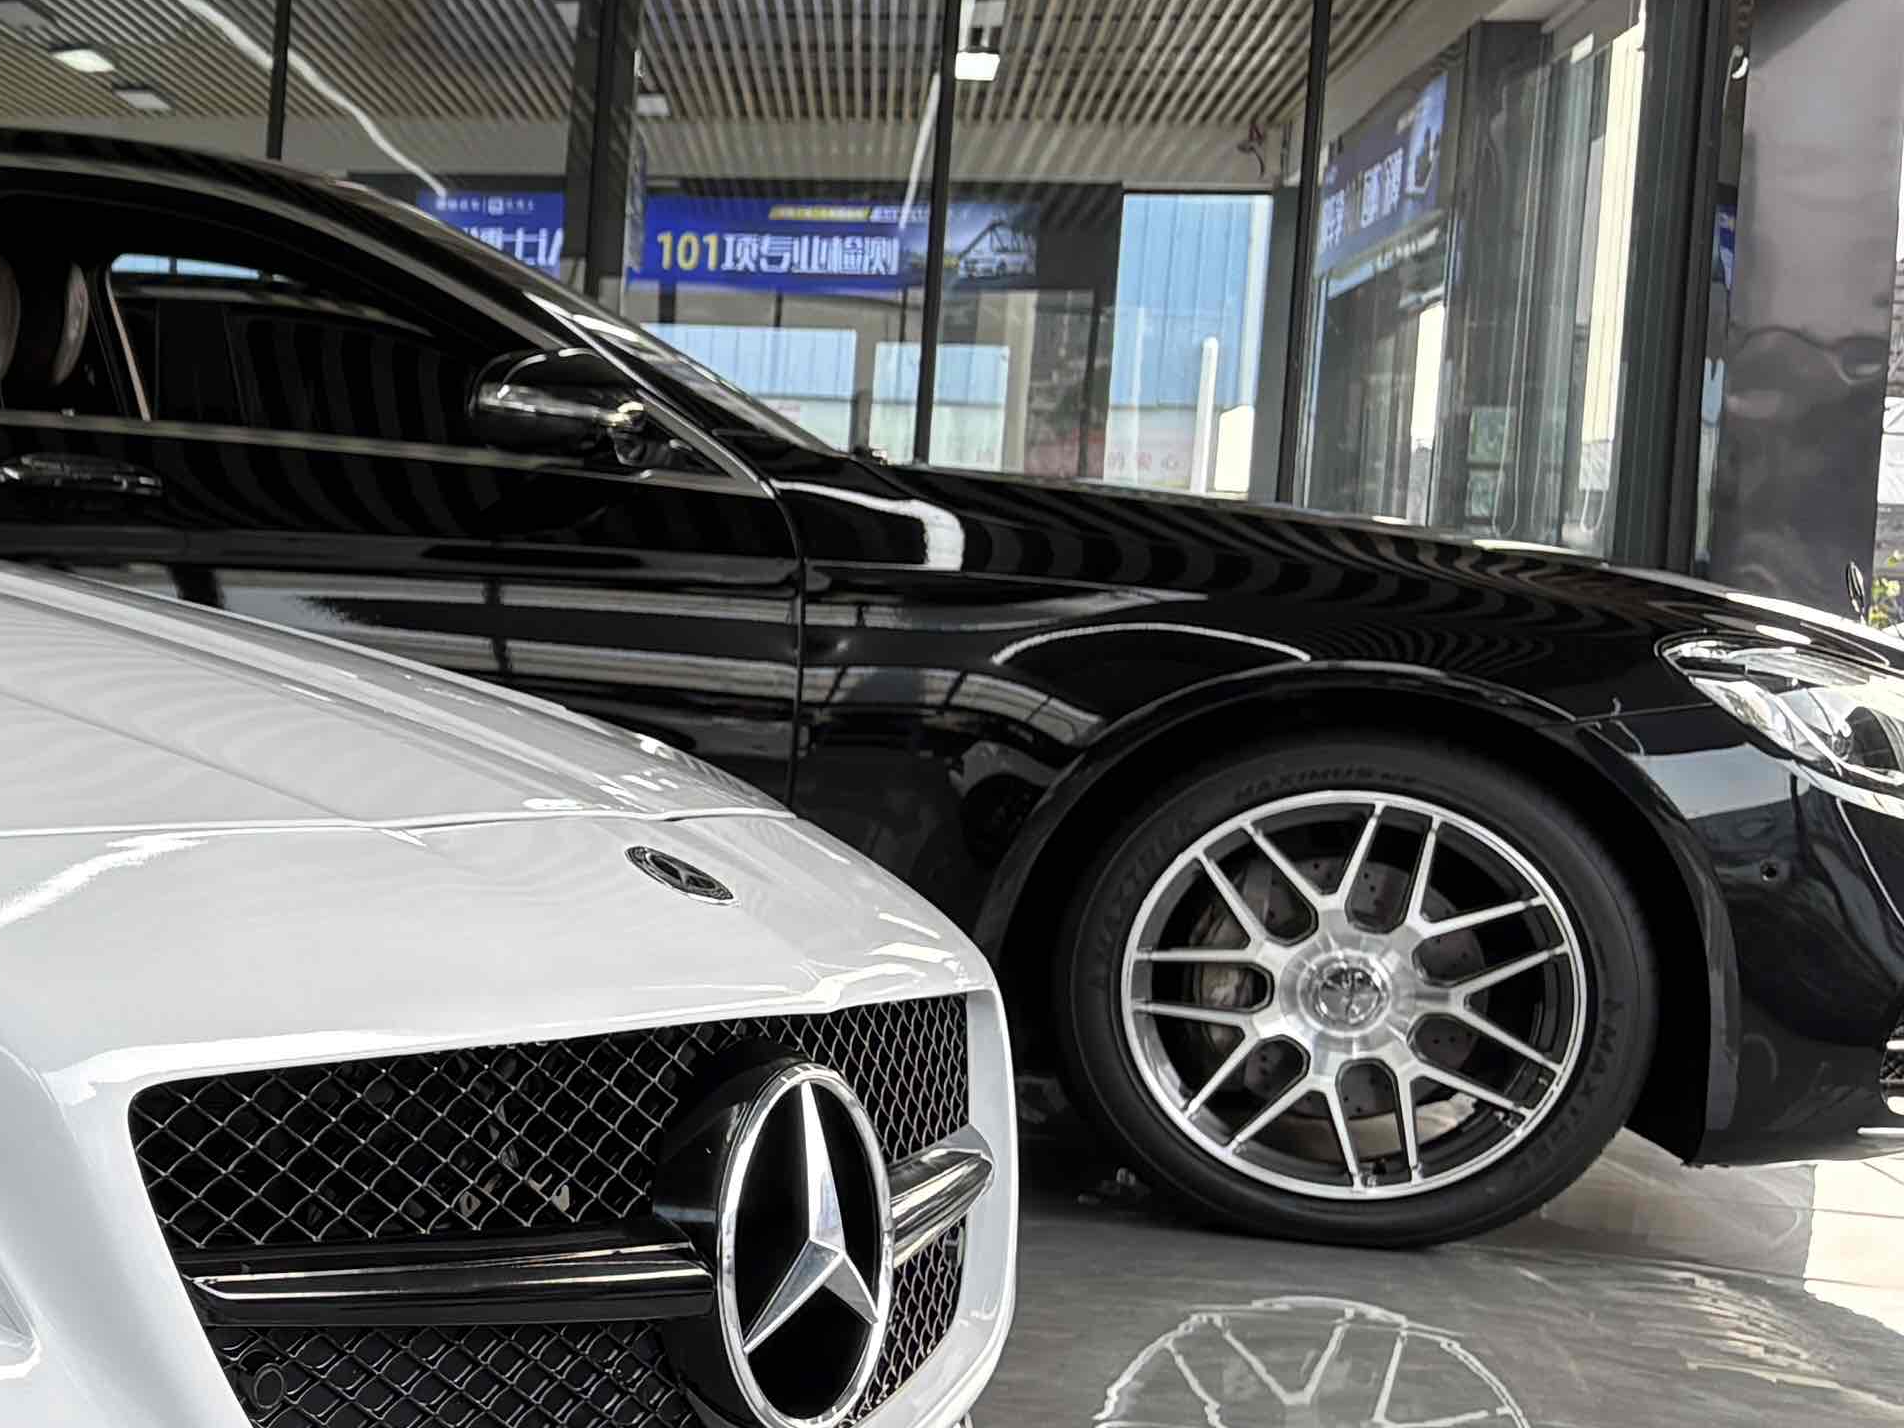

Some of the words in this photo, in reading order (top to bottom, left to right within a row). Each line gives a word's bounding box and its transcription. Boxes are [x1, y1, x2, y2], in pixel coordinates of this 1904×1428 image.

[656, 229, 901, 276] 101项专业检测
